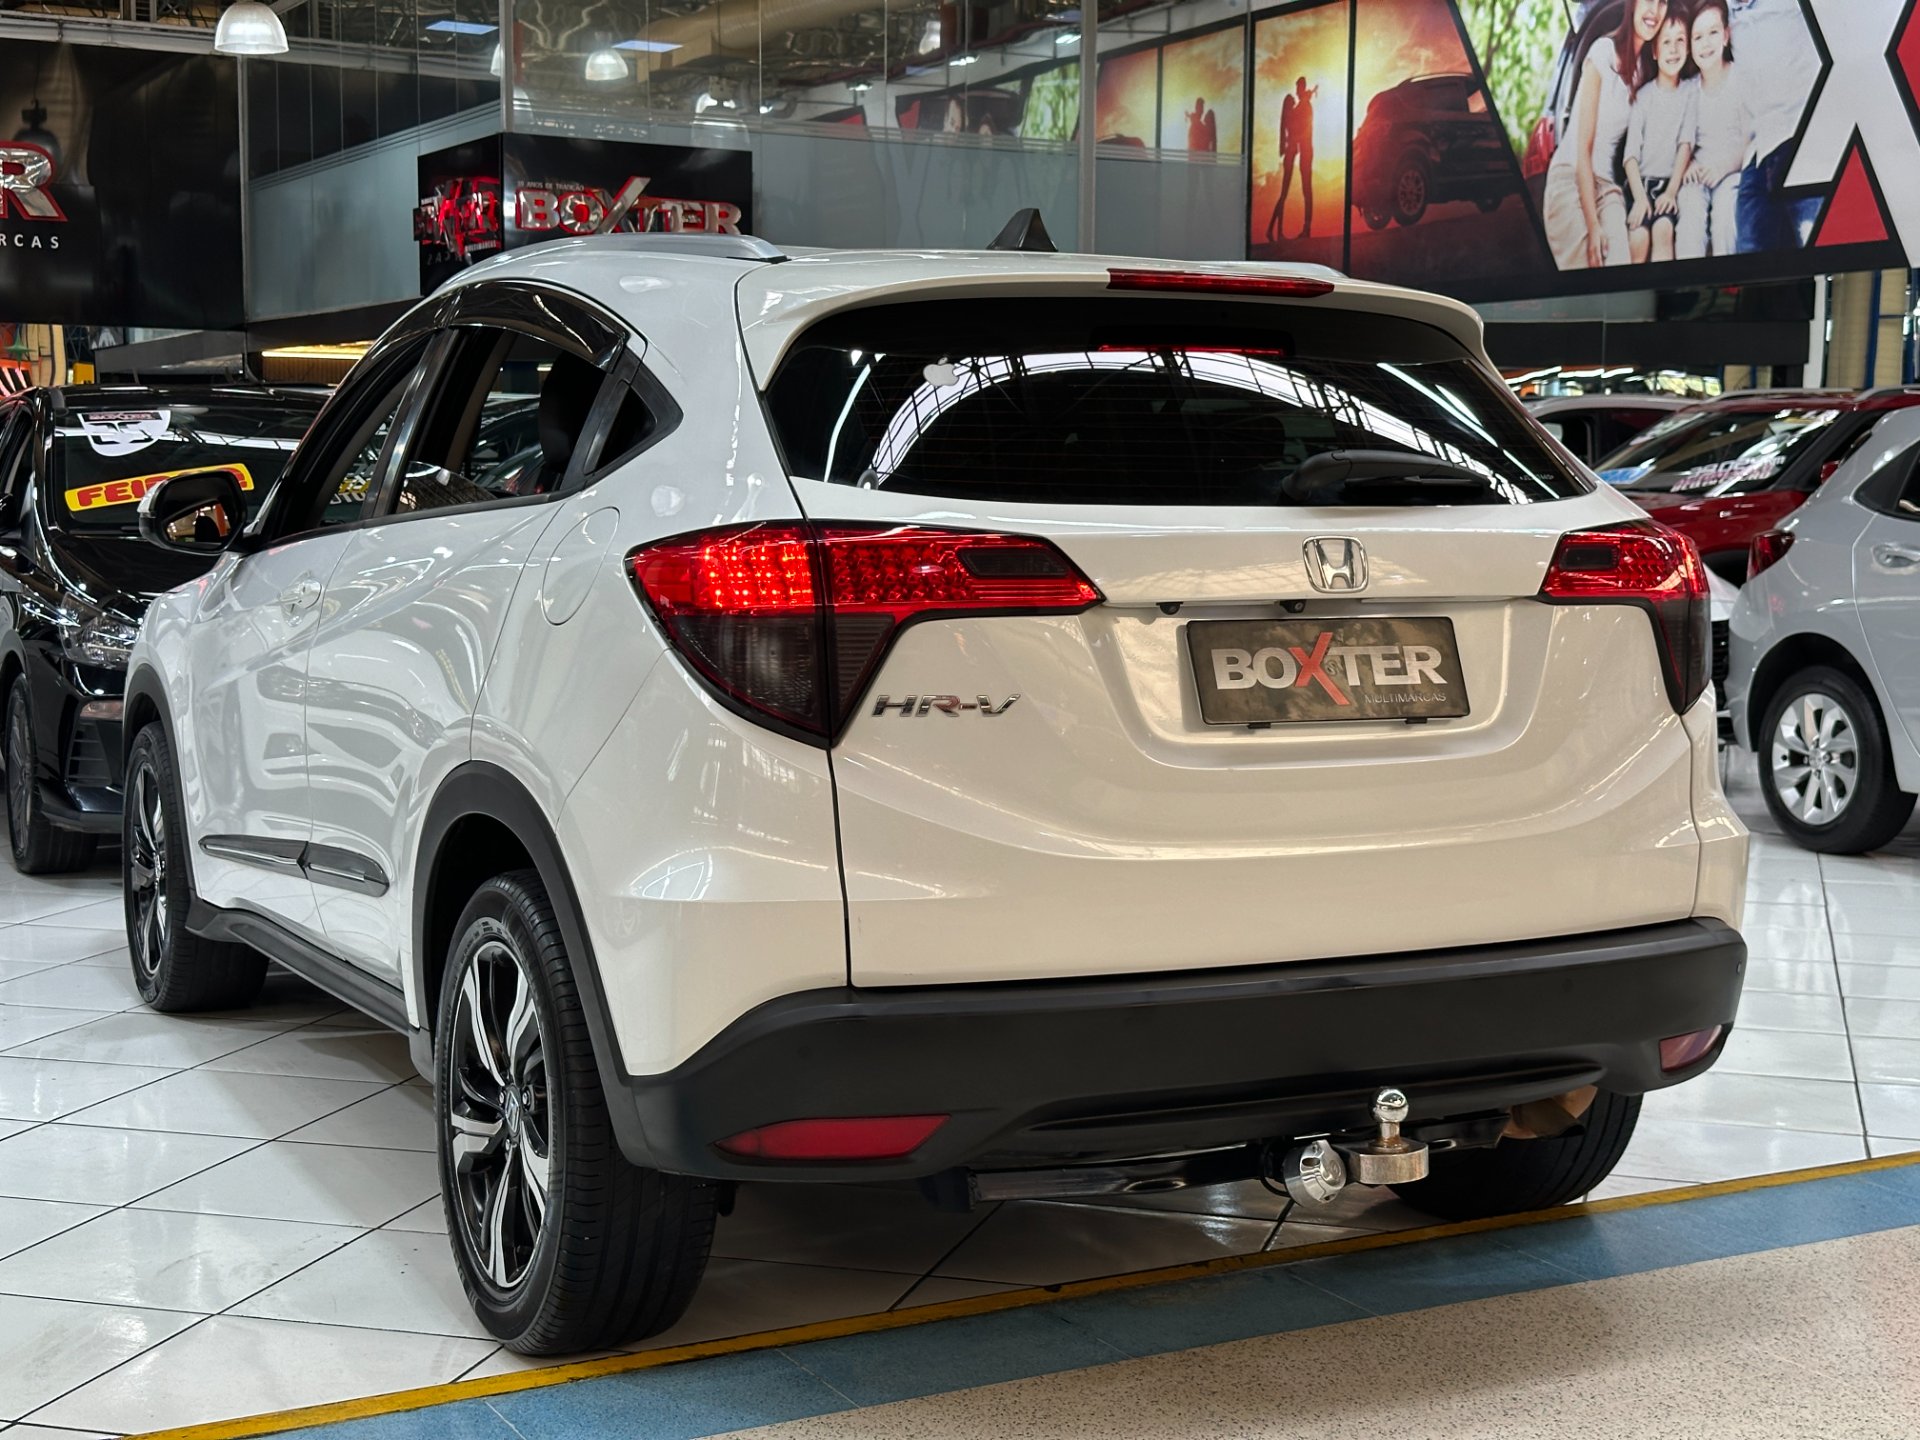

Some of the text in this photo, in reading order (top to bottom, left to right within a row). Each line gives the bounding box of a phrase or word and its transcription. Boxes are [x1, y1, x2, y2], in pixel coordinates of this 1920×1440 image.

[515, 175, 742, 235] BOXTER
[1211, 631, 1448, 706] BOXTER
[871, 693, 1022, 717] HR-V
[1365, 691, 1447, 705] MULTIMARCAS
